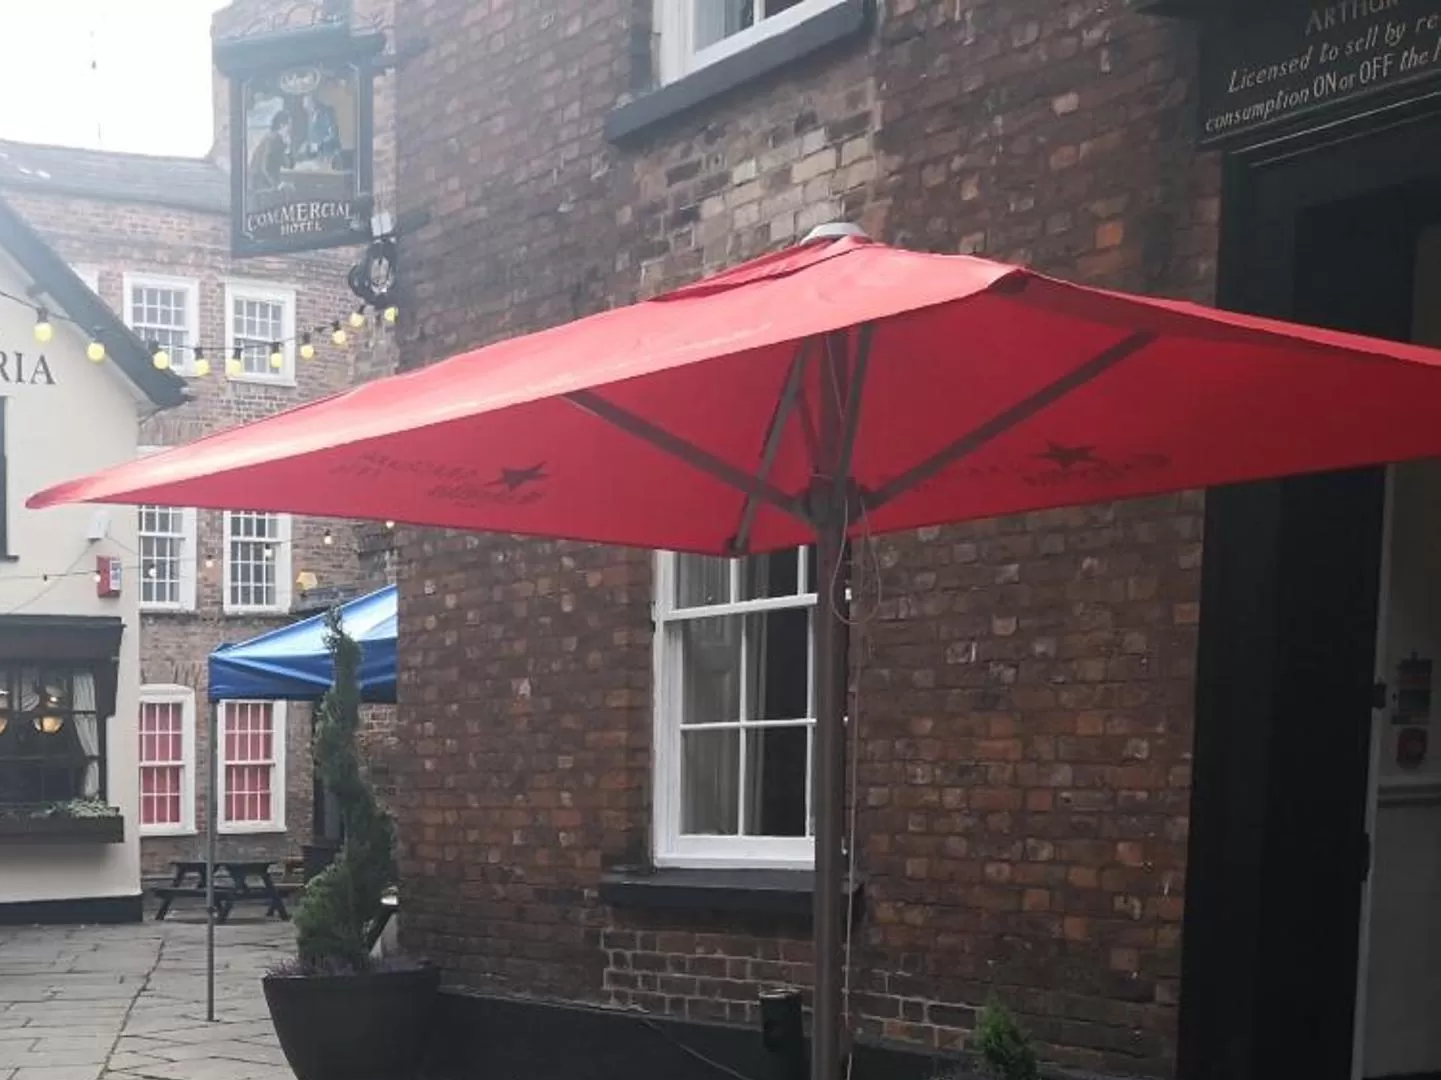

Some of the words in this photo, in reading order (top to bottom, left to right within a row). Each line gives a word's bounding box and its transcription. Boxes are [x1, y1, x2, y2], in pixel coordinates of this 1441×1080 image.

[1205, 89, 1309, 132] consumption
[1313, 71, 1337, 98] ON
[1360, 52, 1395, 84] OFF
[1400, 45, 1429, 72] the
[1227, 45, 1313, 93] Licensed
[1320, 42, 1339, 64] to
[1344, 24, 1378, 56] sell
[1385, 20, 1406, 47] by
[247, 201, 352, 232] COMMERCIAL
